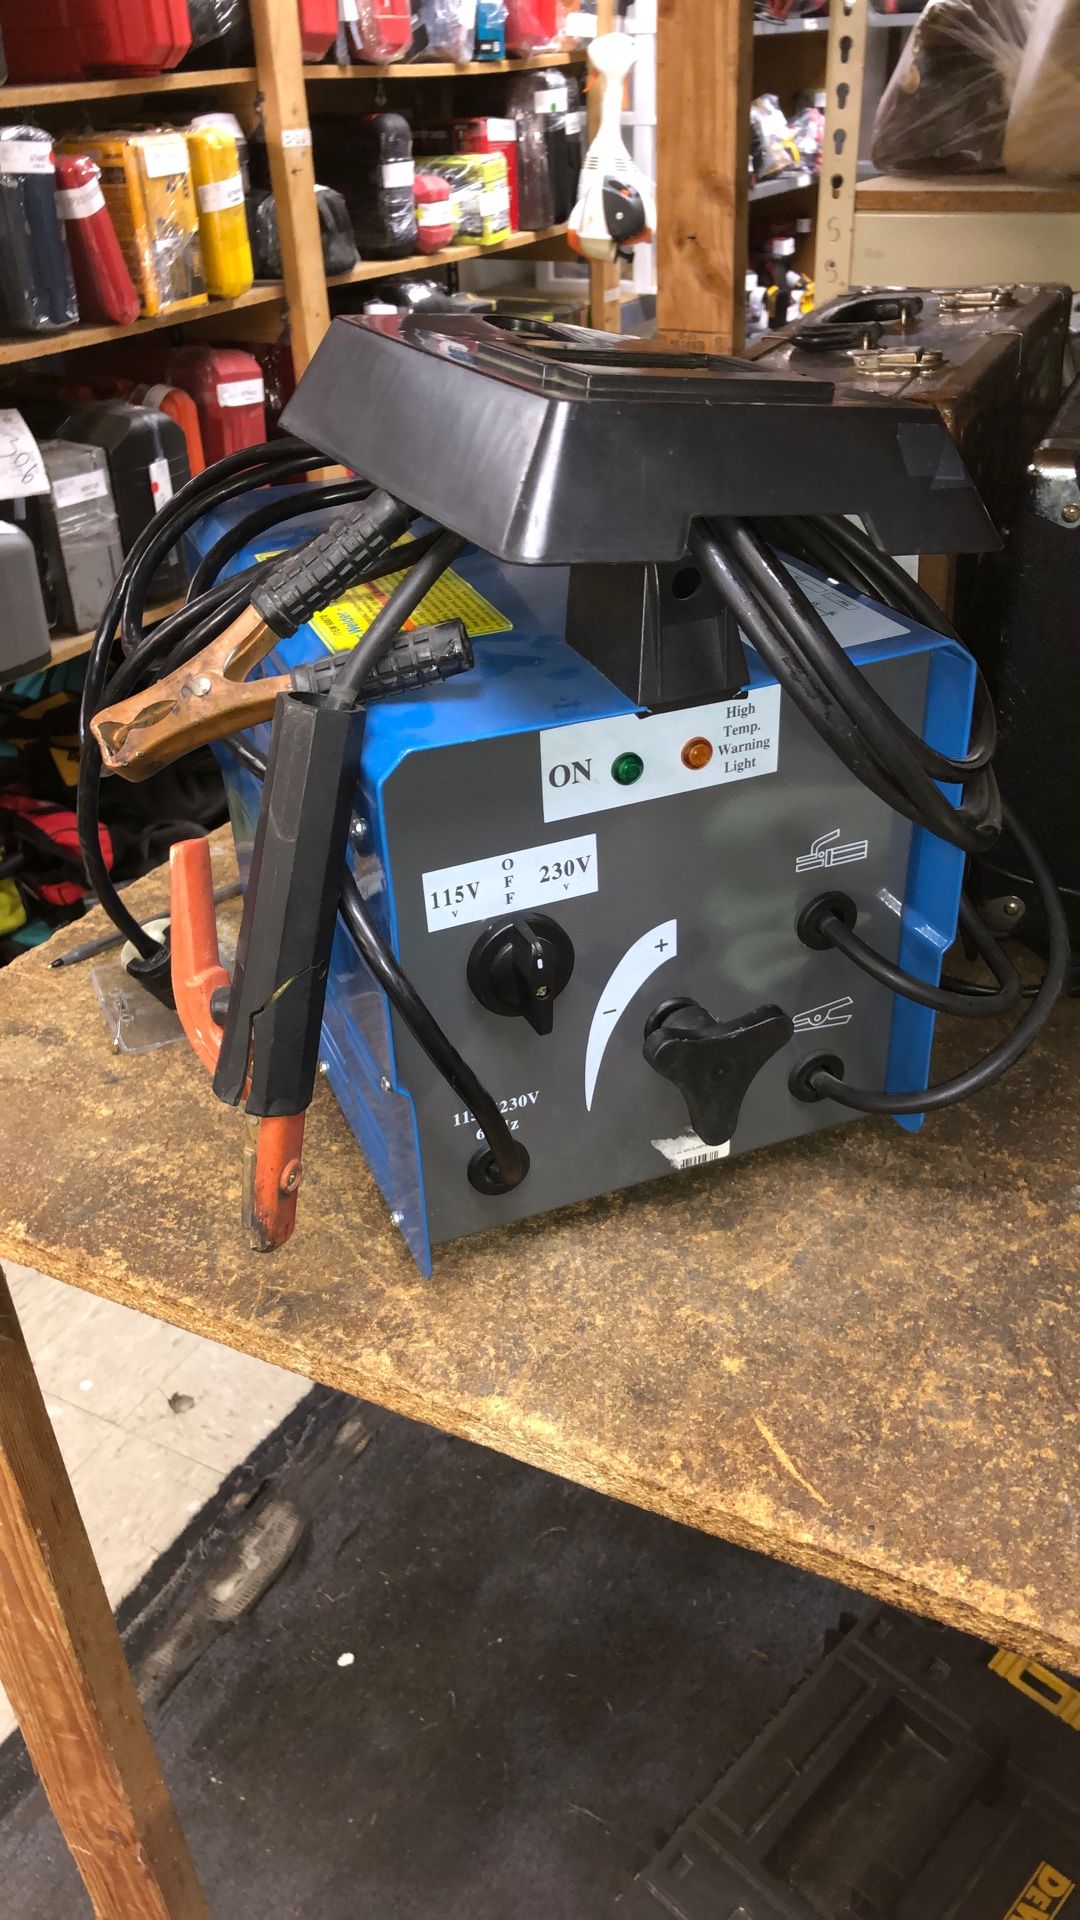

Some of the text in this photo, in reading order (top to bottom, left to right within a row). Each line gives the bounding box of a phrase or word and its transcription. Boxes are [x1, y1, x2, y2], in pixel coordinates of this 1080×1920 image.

[726, 703, 756, 719] High
[723, 721, 761, 738] Temp.
[718, 738, 770, 756] Warning
[549, 758, 592, 788] ON
[724, 757, 756, 774] Light
[539, 855, 591, 883] 230V
[431, 881, 480, 909] 115V
